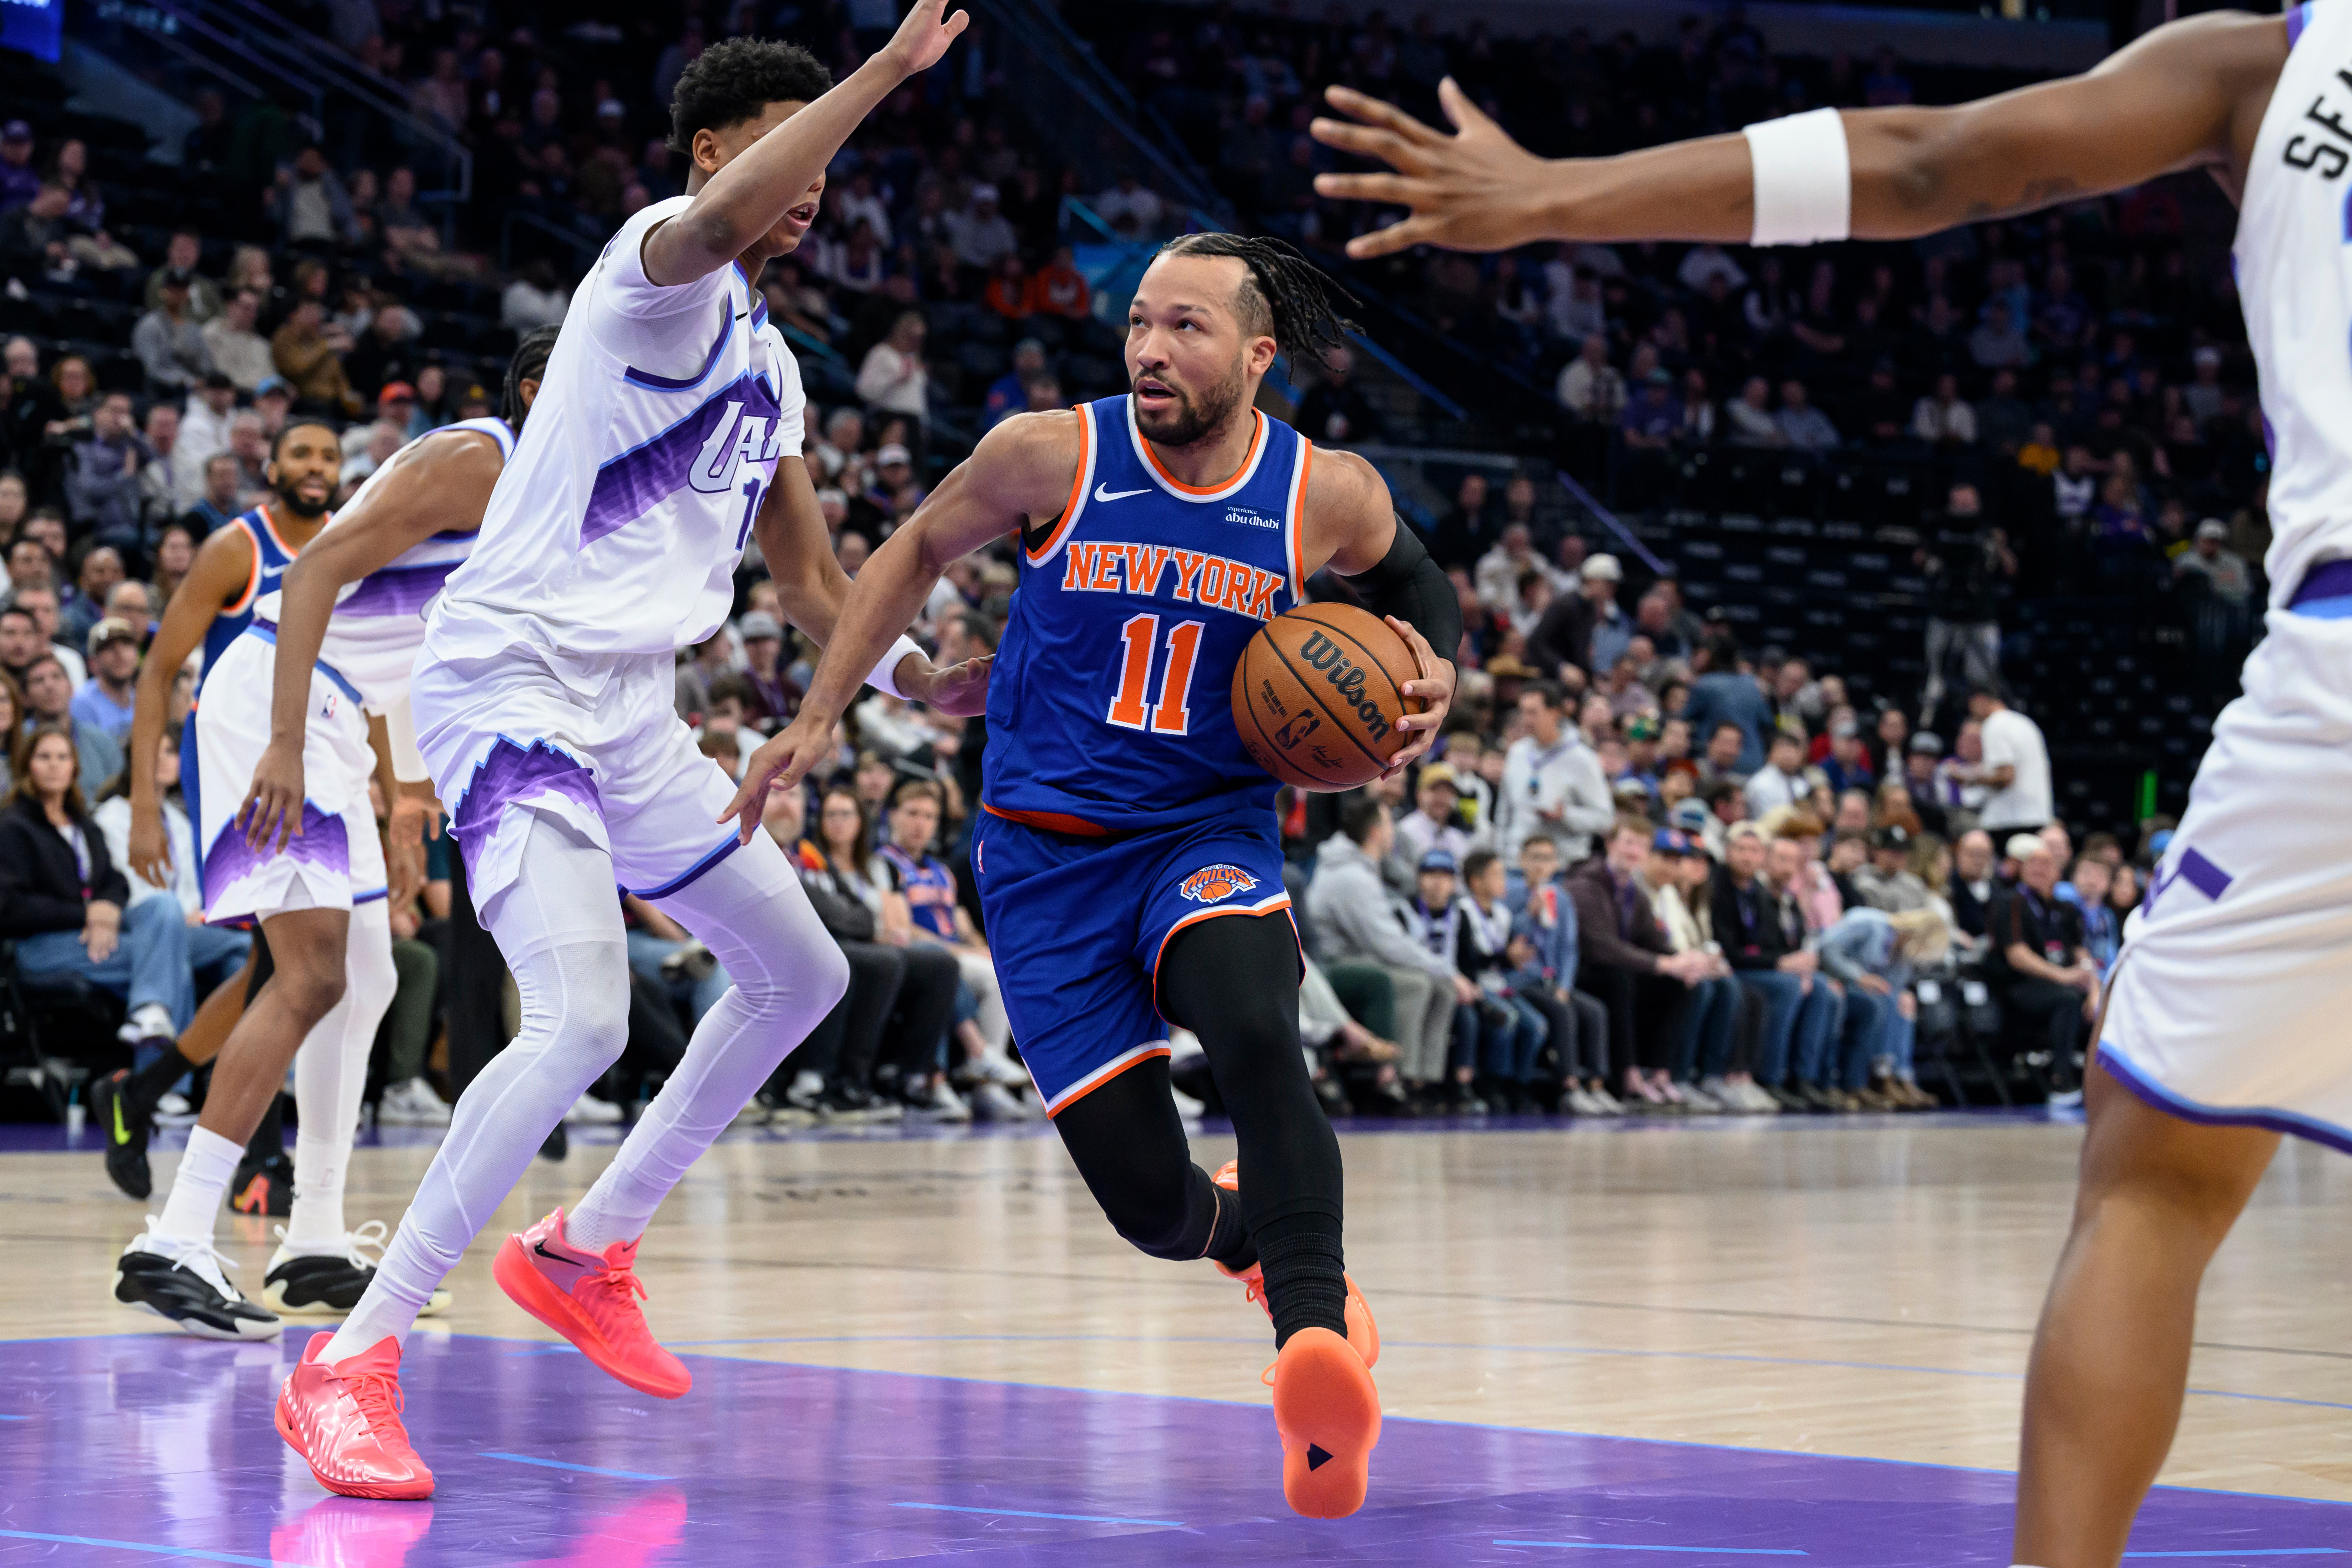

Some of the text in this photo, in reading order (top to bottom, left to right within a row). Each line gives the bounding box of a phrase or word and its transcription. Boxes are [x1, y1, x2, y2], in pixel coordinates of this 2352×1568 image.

[2283, 60, 2352, 179] SE
[1225, 513, 1280, 529] abu dhabi
[1228, 506, 1257, 515] experience
[1061, 541, 1285, 623] NEW YORK
[1106, 613, 1205, 736] 11
[1263, 679, 1275, 698] OFFICIAL
[1271, 695, 1282, 709] GAME
[1278, 706, 1288, 718] BALL
[1299, 630, 1390, 745] Wilson
[1183, 868, 1253, 894] KNICKS
